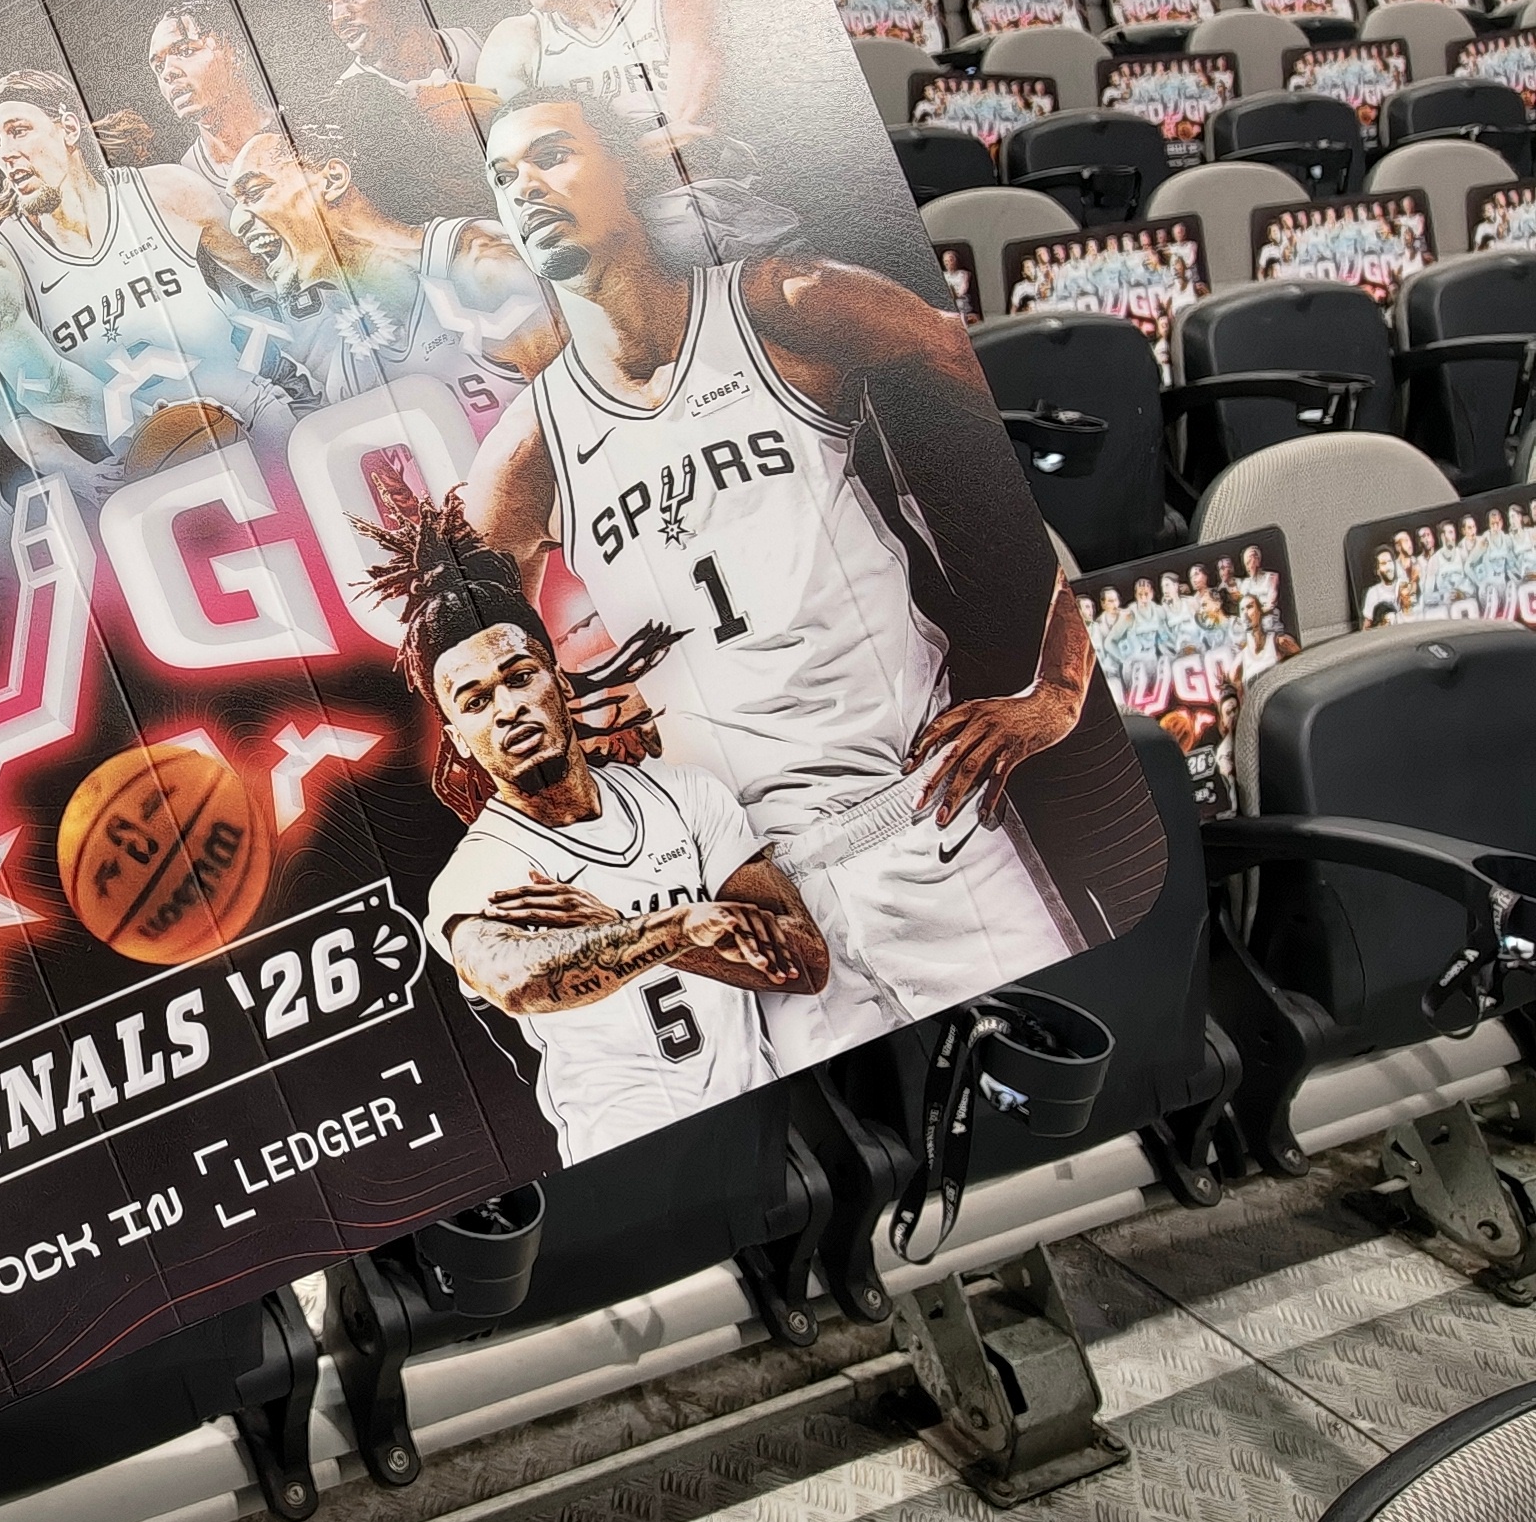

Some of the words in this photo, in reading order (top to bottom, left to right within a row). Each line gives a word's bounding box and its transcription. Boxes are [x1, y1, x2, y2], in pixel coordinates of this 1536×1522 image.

[53, 265, 184, 354] SPURS
[694, 377, 744, 410] LEDGER
[99, 373, 483, 675] GO
[592, 429, 795, 566] SPURS
[689, 548, 754, 651] 1
[655, 842, 689, 869] LEDGER
[225, 926, 362, 1040] '26
[638, 971, 705, 1065] 5
[108, 1185, 186, 1247] IN
[231, 1095, 405, 1195] LEDGER
